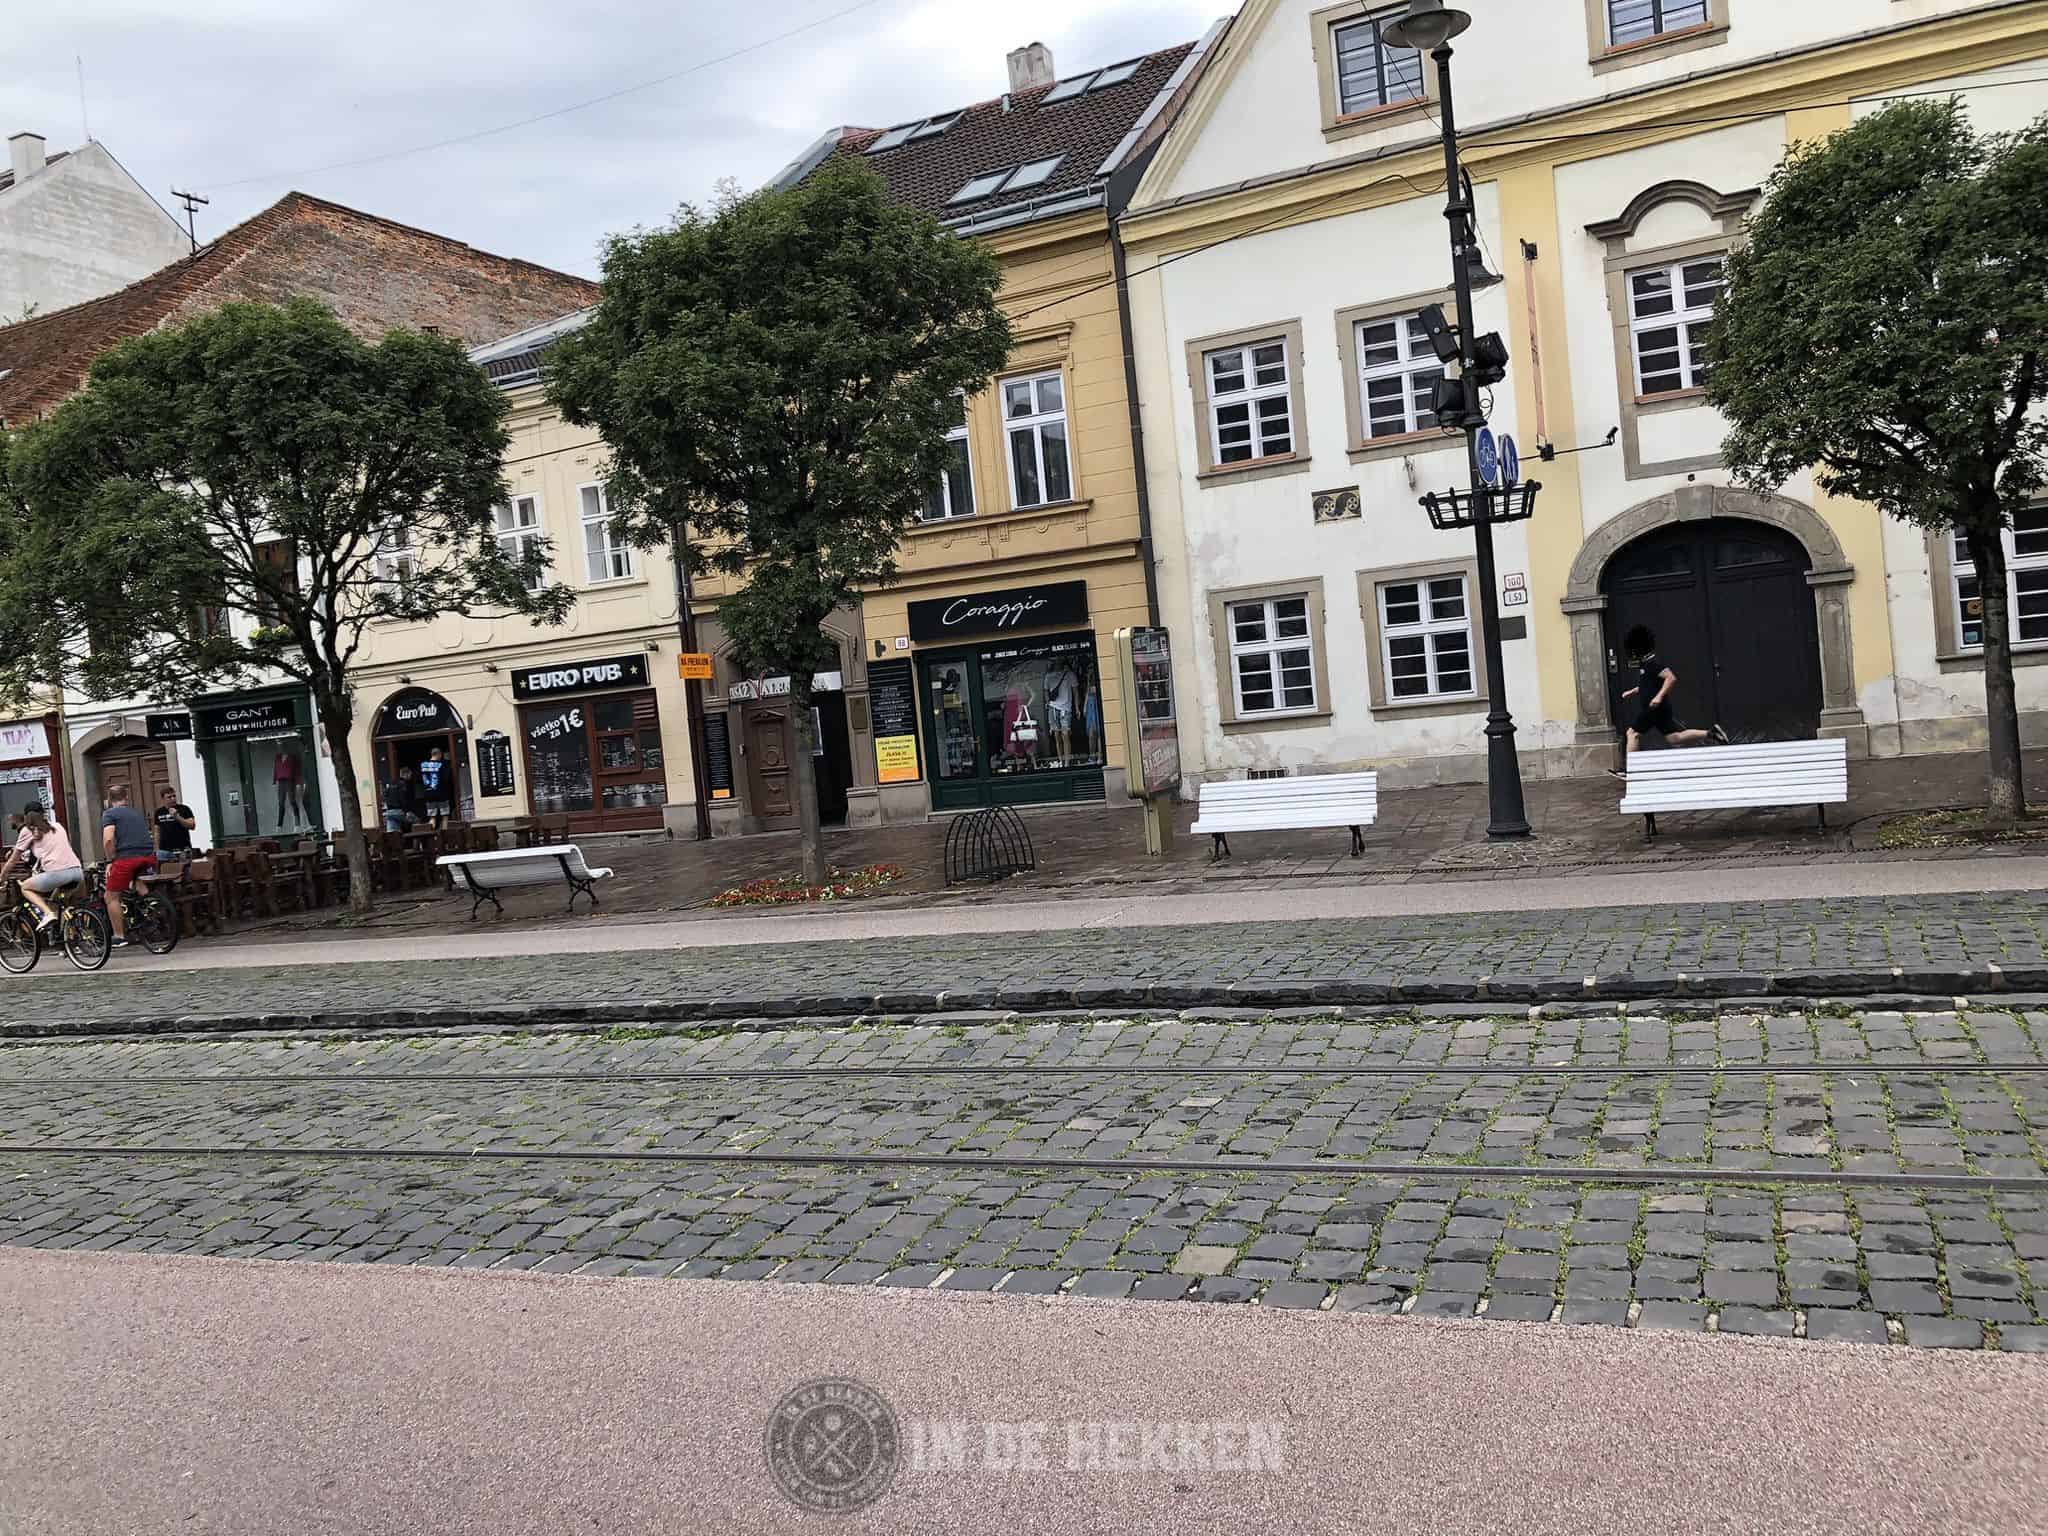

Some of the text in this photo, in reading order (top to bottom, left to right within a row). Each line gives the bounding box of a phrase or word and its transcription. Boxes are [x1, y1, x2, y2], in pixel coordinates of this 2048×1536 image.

[1507, 577, 1521, 587] 100
[942, 595, 1048, 627] Coraggio
[528, 663, 622, 691] EURO PUB
[226, 706, 272, 720] GANT
[396, 703, 438, 720] Euro Pub
[214, 718, 287, 733] TOMMY HILFIGER
[530, 719, 560, 739] všetko
[550, 708, 584, 740] za 1€
